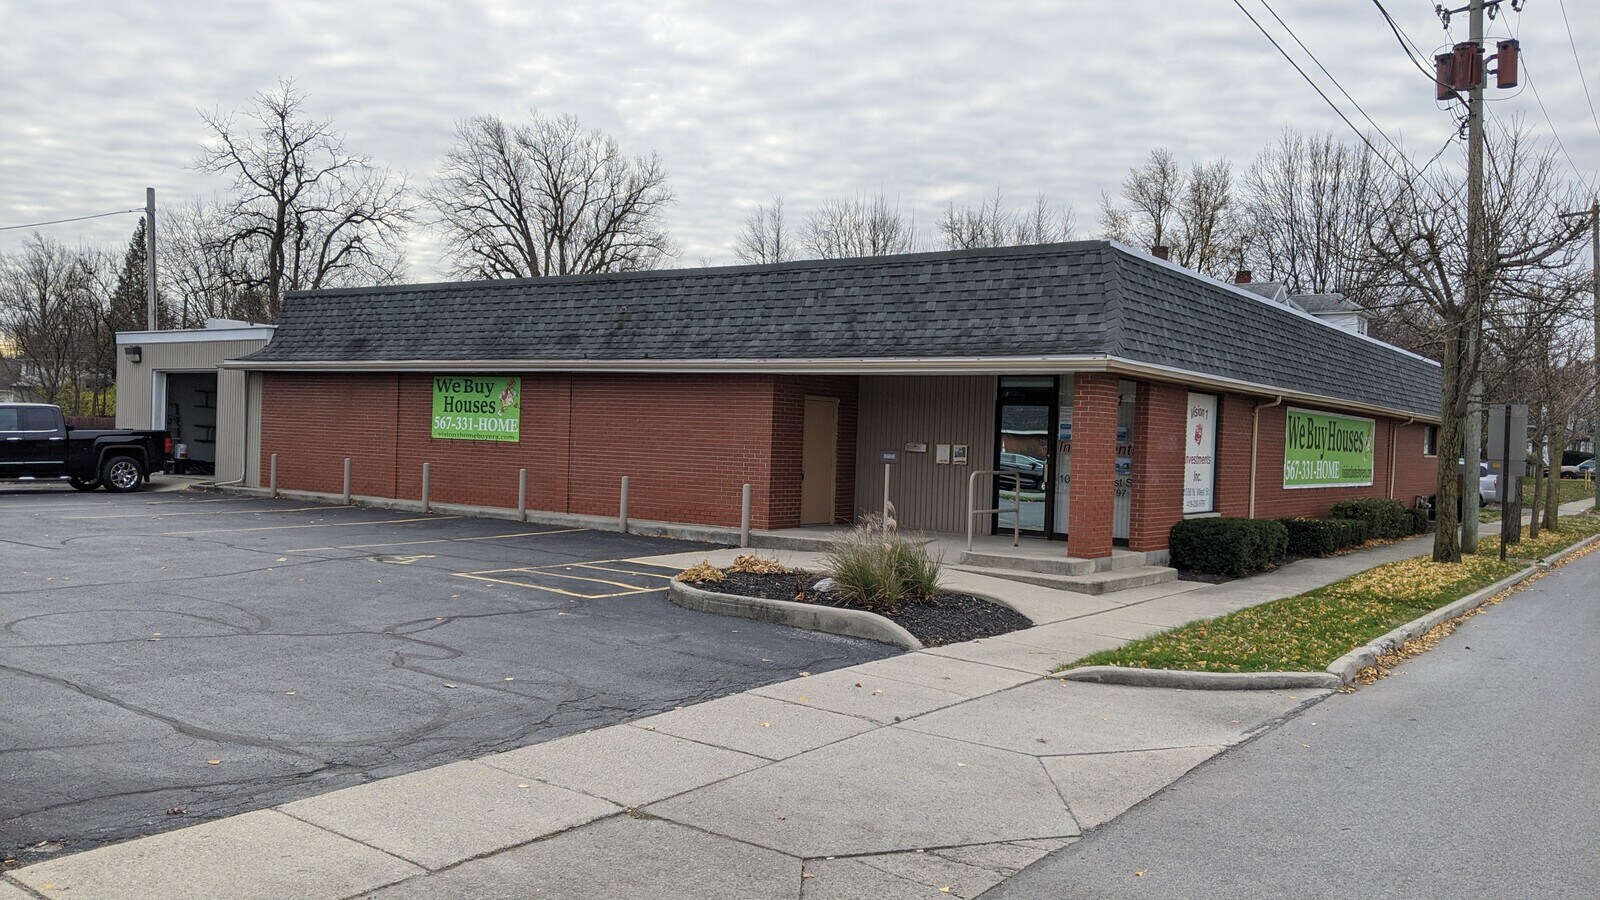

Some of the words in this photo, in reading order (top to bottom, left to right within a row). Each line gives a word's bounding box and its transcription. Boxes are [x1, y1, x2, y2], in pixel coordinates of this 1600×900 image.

[435, 378, 460, 393] We
[463, 379, 495, 398] Buy
[443, 396, 496, 414] Houses
[434, 416, 519, 433] 567-331-HOME
[1288, 415, 1306, 450] We
[1306, 417, 1328, 460] Buy
[1327, 421, 1364, 453] Houses
[1185, 454, 1211, 464] nvestments
[1060, 474, 1071, 484] 10
[1285, 460, 1340, 480] 567-331-HOME
